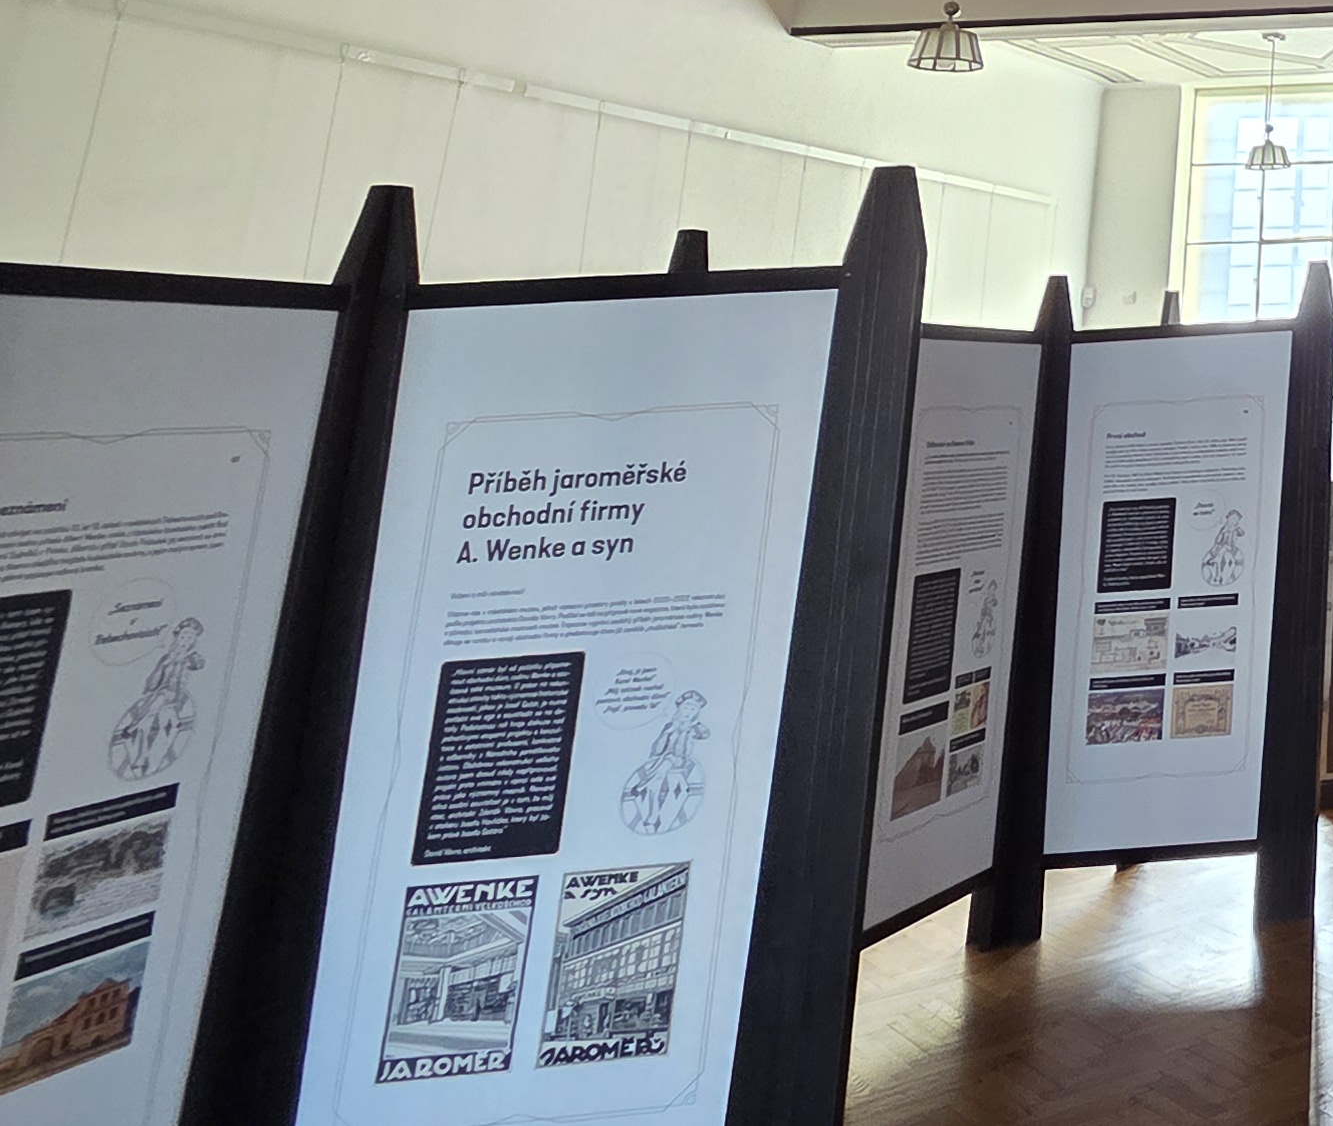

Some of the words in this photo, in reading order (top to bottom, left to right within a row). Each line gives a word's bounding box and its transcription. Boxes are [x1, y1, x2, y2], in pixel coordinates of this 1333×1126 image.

[467, 468, 547, 495] Příběh
[549, 460, 687, 497] jaroměřské
[462, 500, 576, 529] obchodní
[580, 499, 645, 525] firmy
[456, 540, 478, 564] A.
[487, 536, 565, 562] Wenke
[571, 540, 586, 556] a
[591, 536, 634, 561] syn
